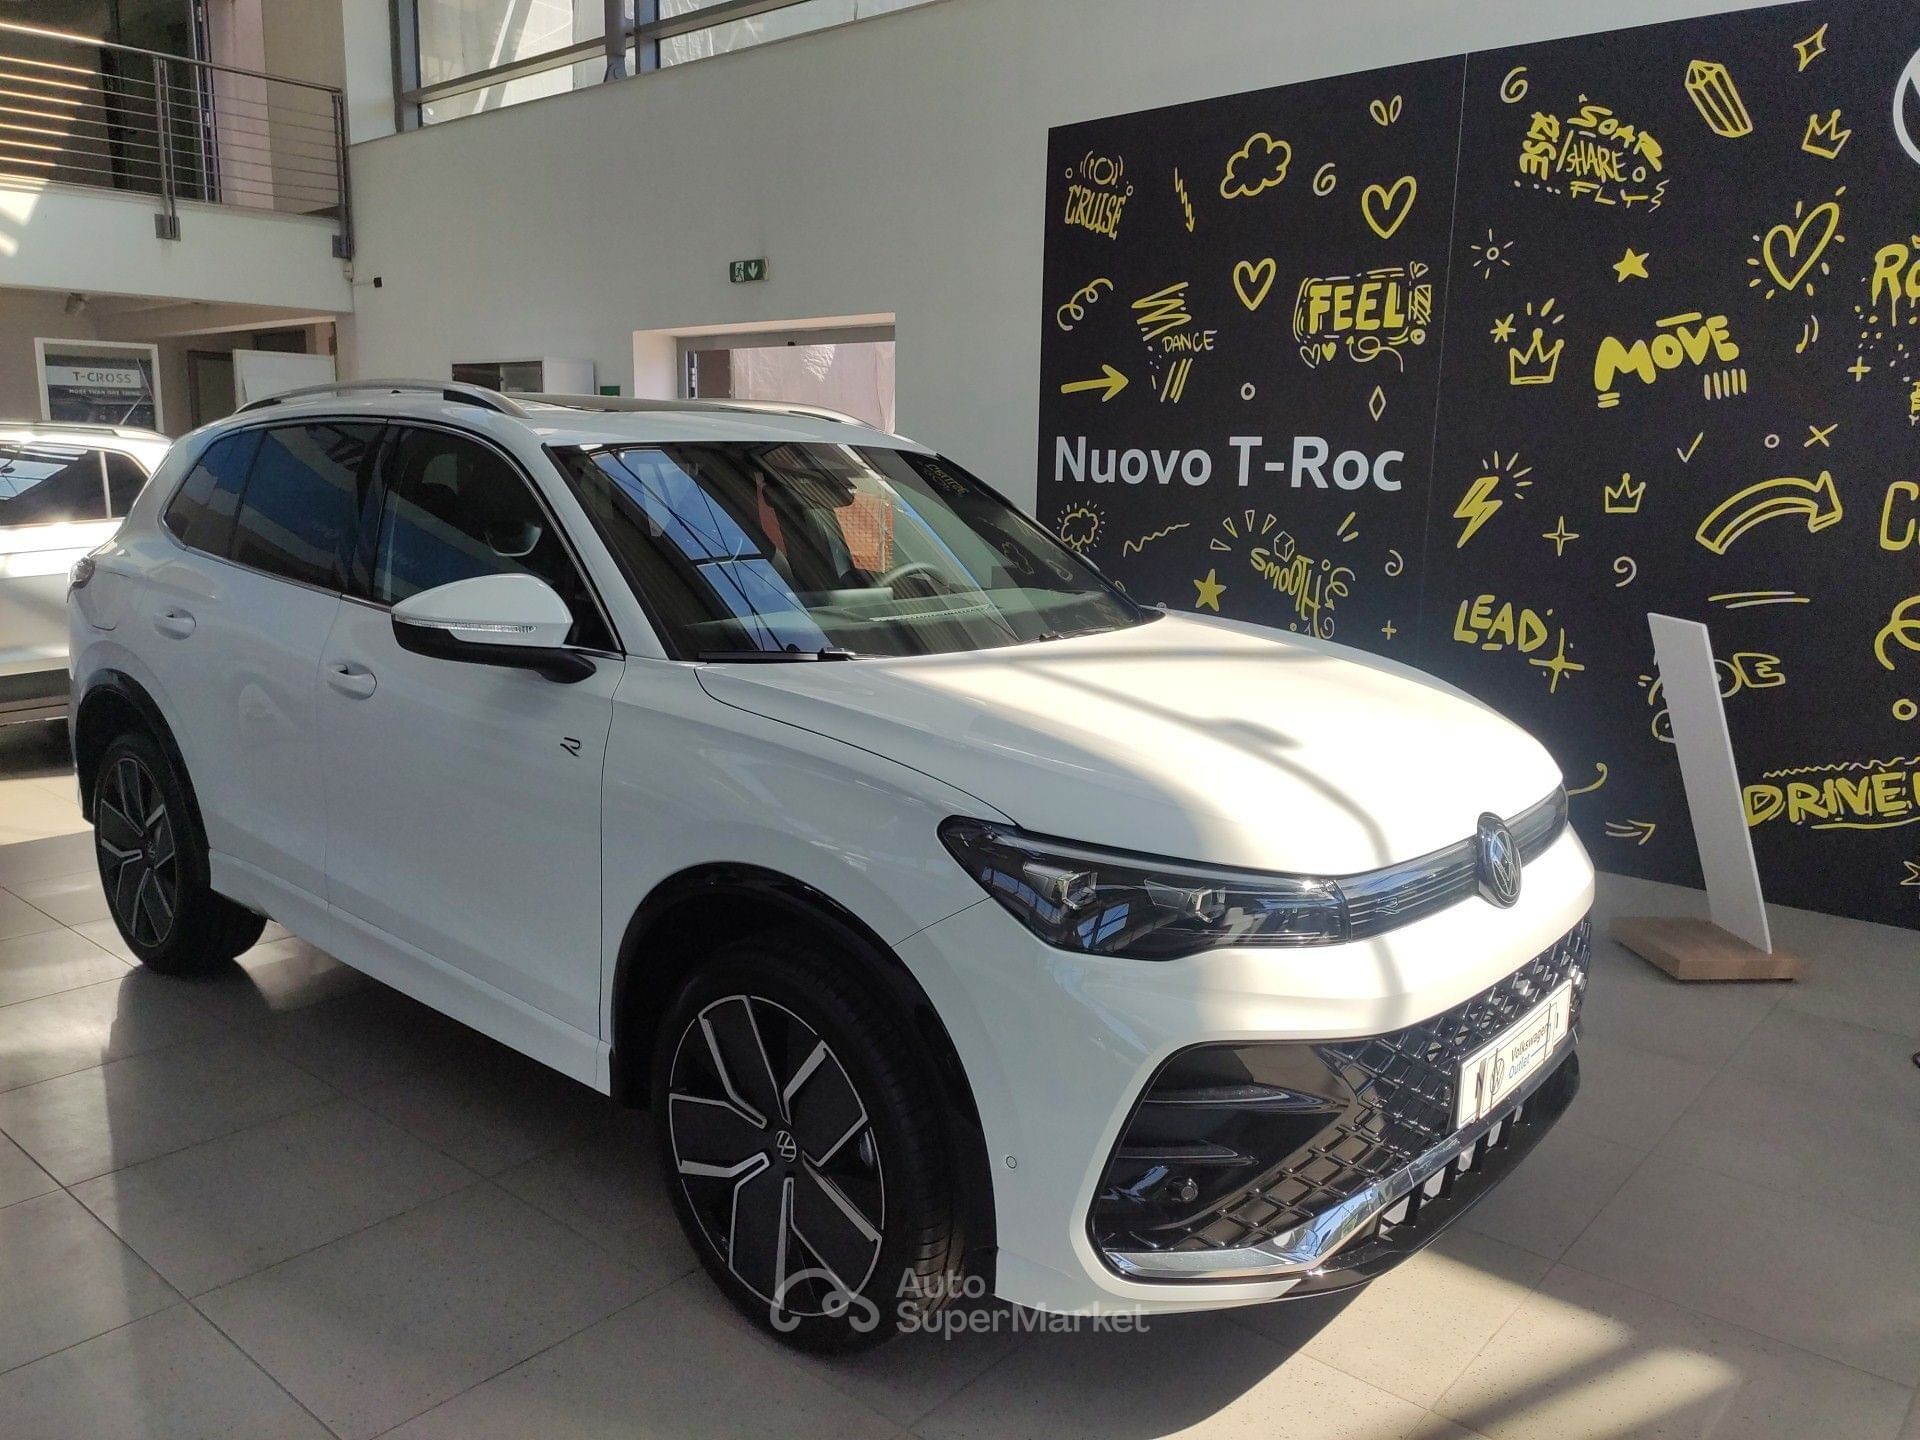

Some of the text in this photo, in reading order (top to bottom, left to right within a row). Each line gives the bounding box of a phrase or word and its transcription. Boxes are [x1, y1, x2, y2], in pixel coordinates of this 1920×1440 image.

[1566, 139, 1628, 183] SHARE
[1064, 184, 1127, 241] CRUISE
[1308, 281, 1405, 335] FEEL
[1161, 329, 1218, 354] DANCE
[1594, 314, 1740, 392] MOVE
[72, 371, 132, 384] T-CROSS
[1054, 435, 1405, 491] Nuovo T-Roc
[1250, 547, 1321, 640] SMOOTH
[1453, 594, 1548, 653] LEAD
[1508, 1053, 1531, 1080] Outlet
[1511, 1022, 1551, 1062] Volkswagen
